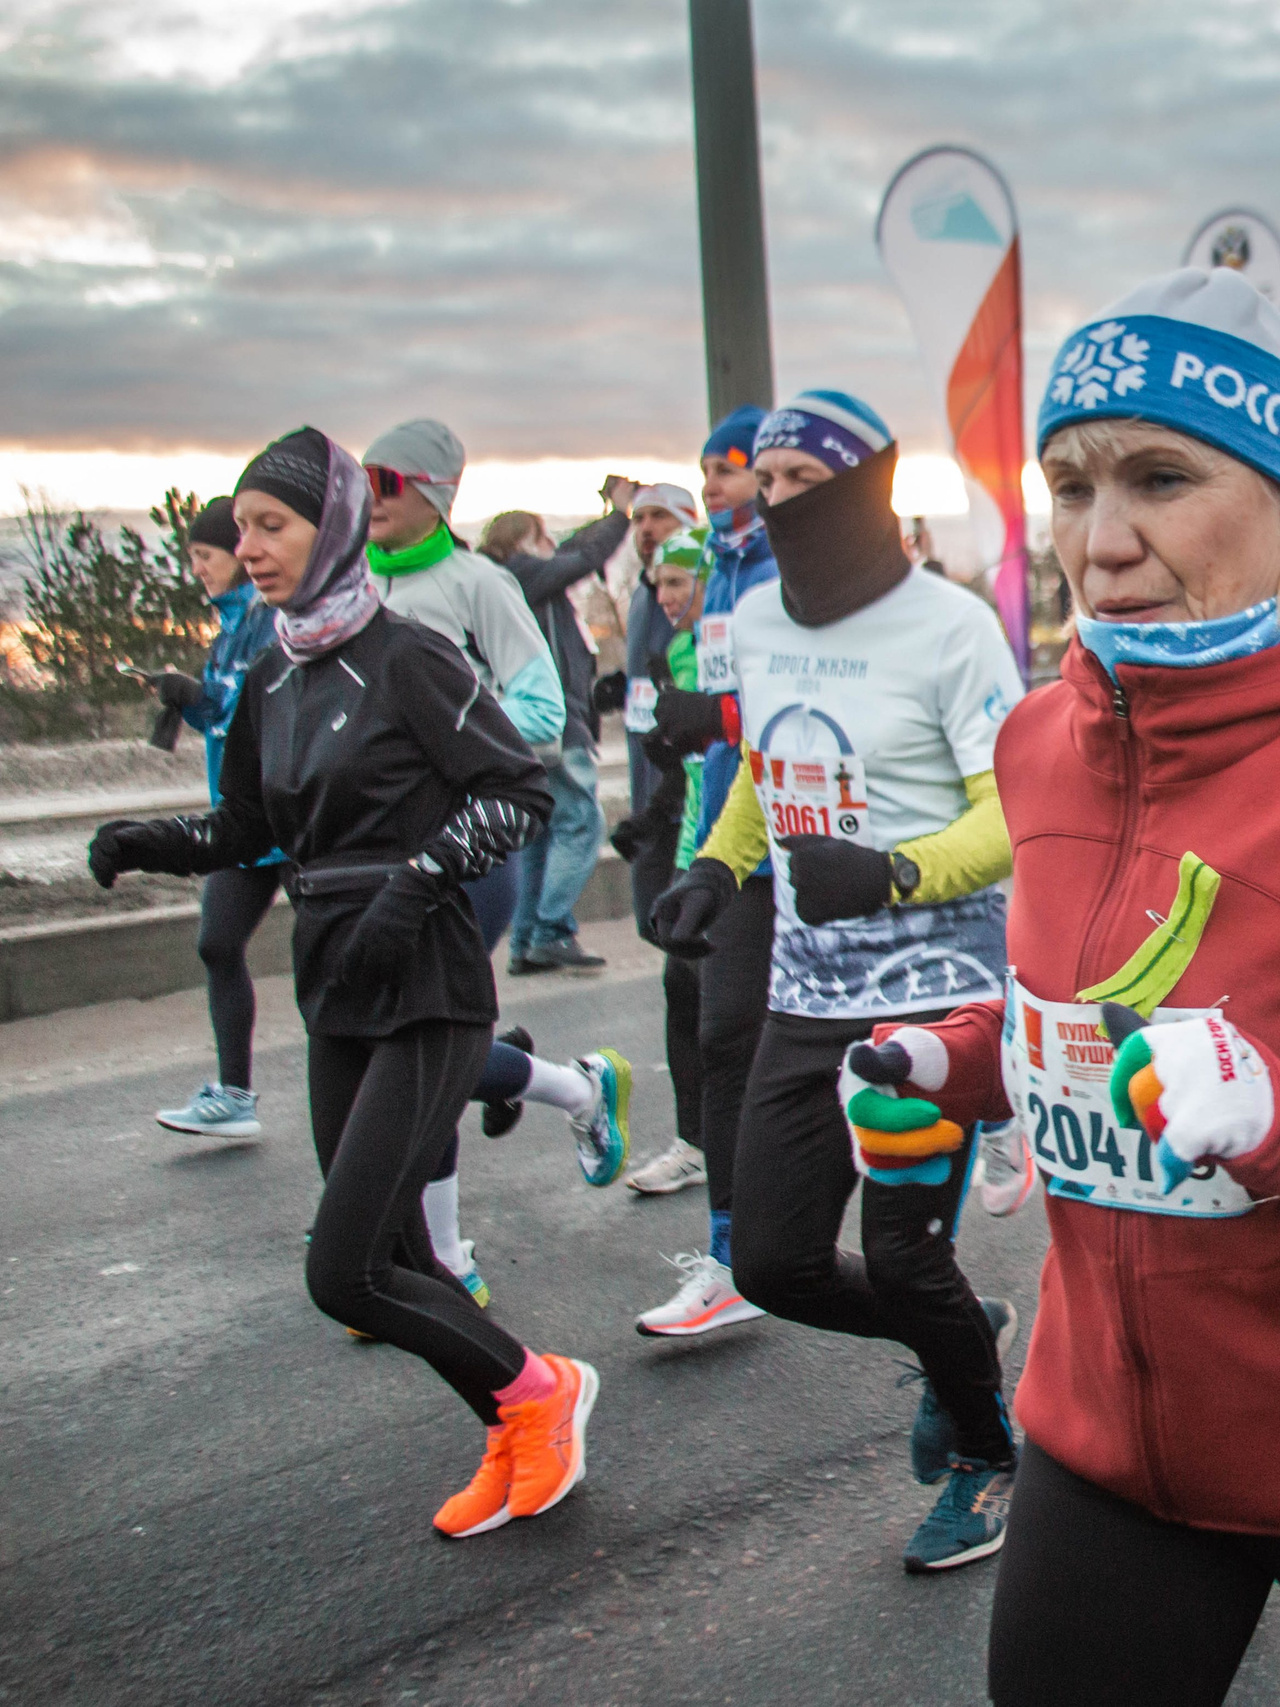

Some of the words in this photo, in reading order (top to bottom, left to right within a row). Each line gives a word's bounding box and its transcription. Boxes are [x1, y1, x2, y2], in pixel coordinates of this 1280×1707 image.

[768, 653, 810, 675] ДОРОГА
[815, 657, 869, 680] ЖИЗНИ
[772, 802, 832, 837] 3061
[1057, 1022, 1111, 1043] ПУЛК
[1062, 1044, 1114, 1065] -ПУШК
